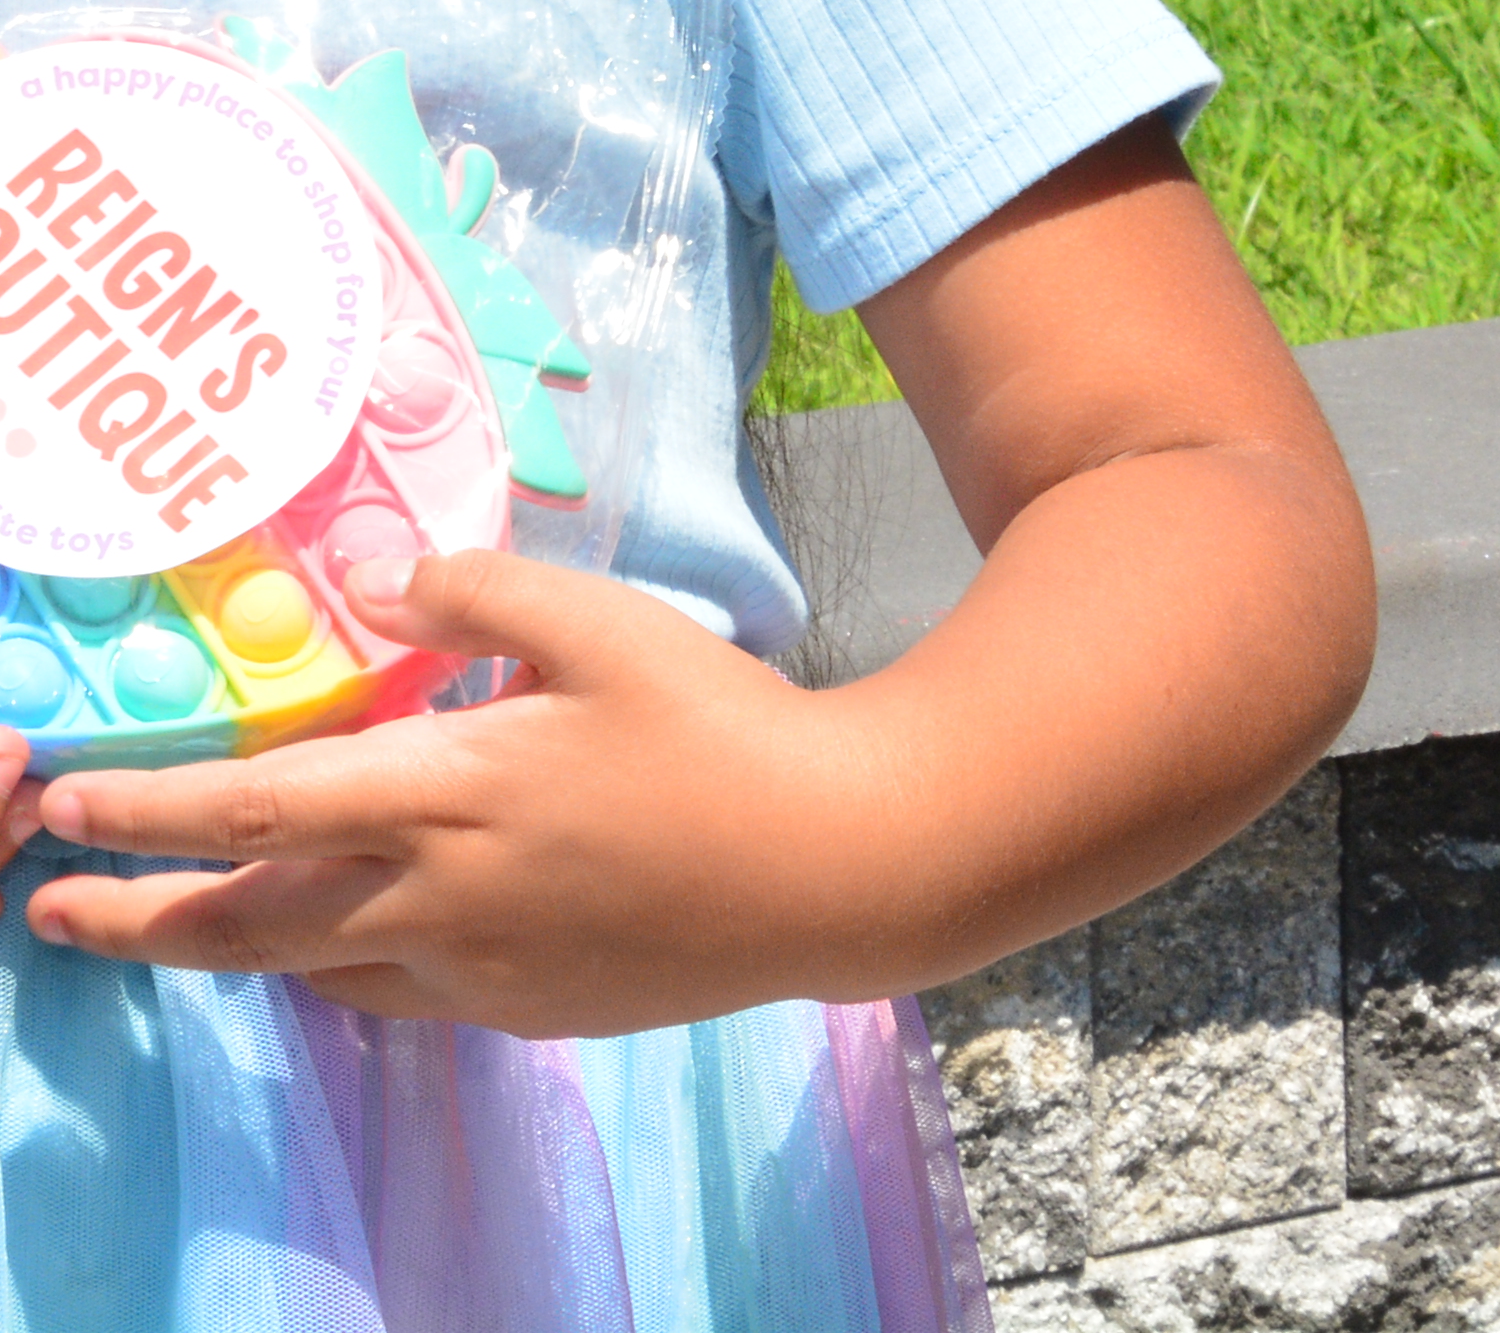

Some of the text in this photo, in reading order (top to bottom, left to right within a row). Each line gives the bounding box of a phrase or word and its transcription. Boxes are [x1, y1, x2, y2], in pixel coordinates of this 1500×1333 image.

[5, 128, 288, 413] REIGN'S
[21, 66, 364, 416] a happy place to shop for your
[49, 526, 134, 560] toys
